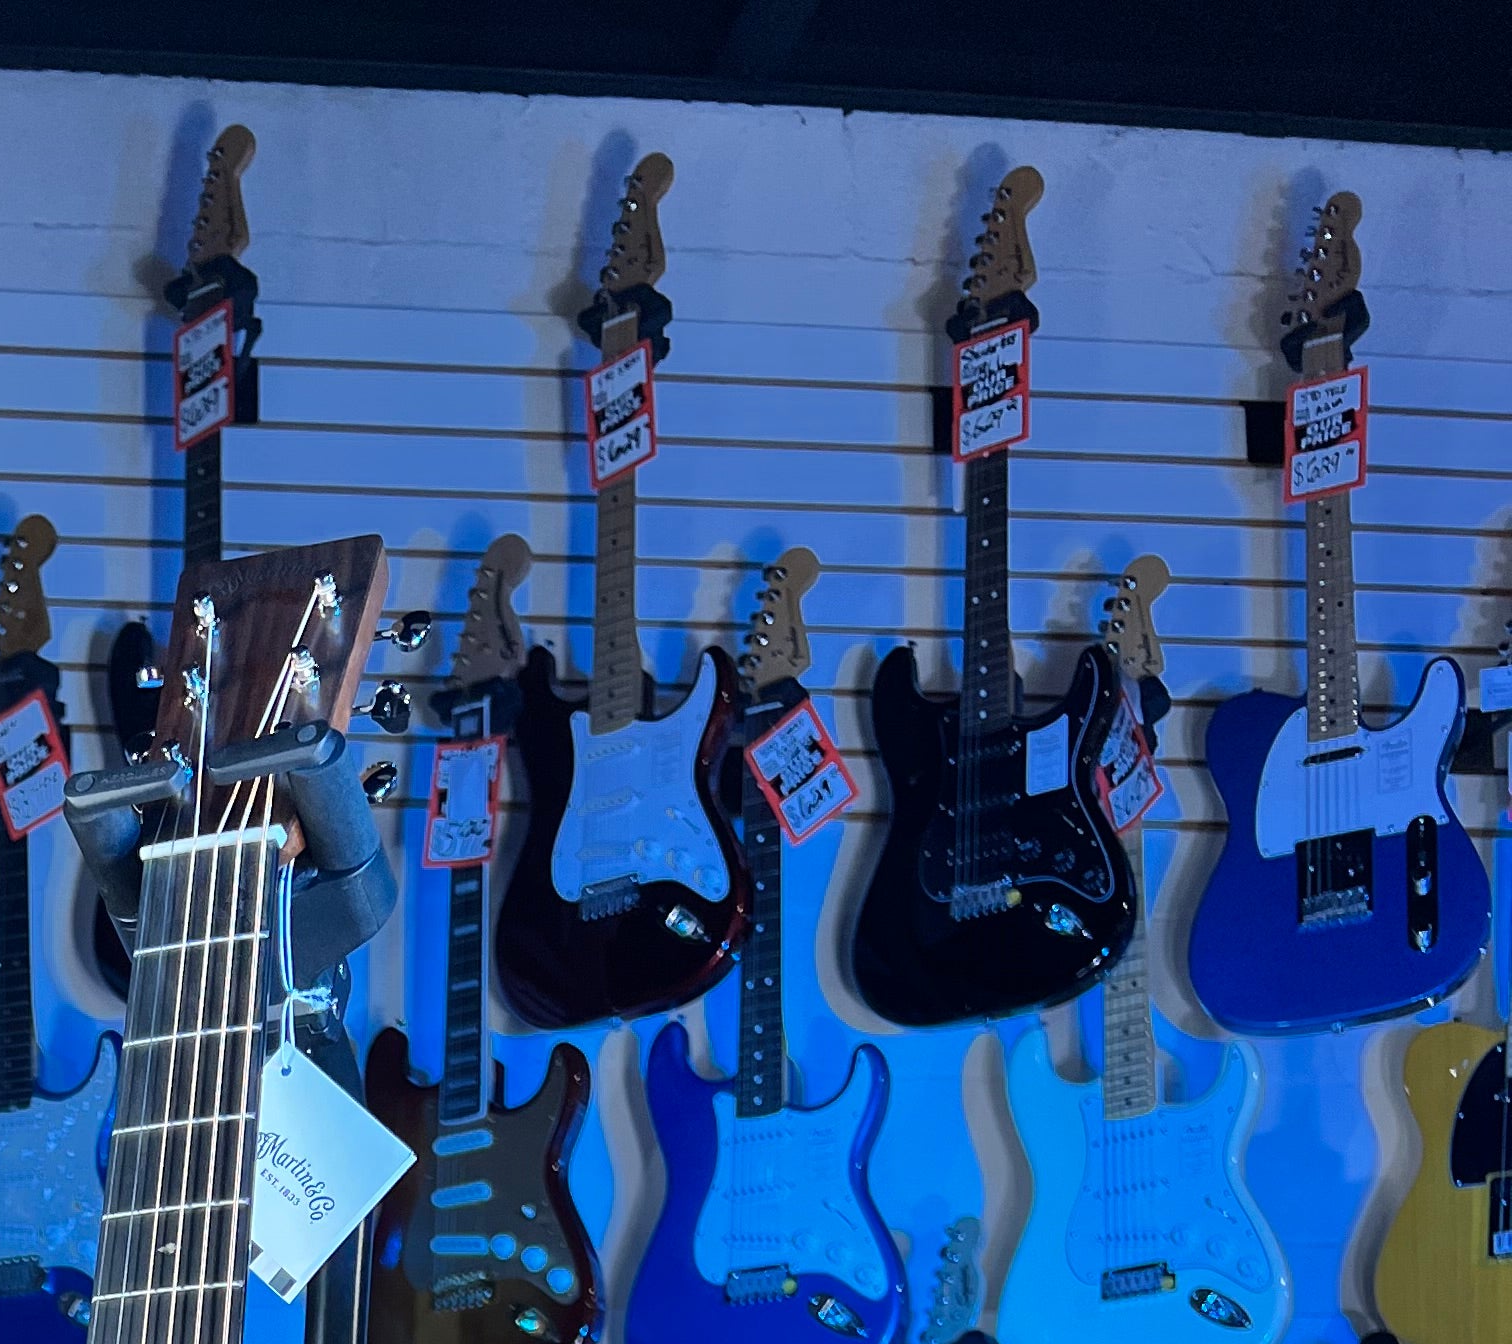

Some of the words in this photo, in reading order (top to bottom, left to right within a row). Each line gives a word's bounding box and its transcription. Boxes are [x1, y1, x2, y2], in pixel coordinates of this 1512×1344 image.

[966, 376, 1016, 410] PRICE
[973, 367, 1006, 392] OUR
[1299, 422, 1353, 450] PRICE
[1306, 413, 1344, 436] OUR
[260, 1168, 279, 1188] EST.
[279, 1185, 301, 1207] 1833
